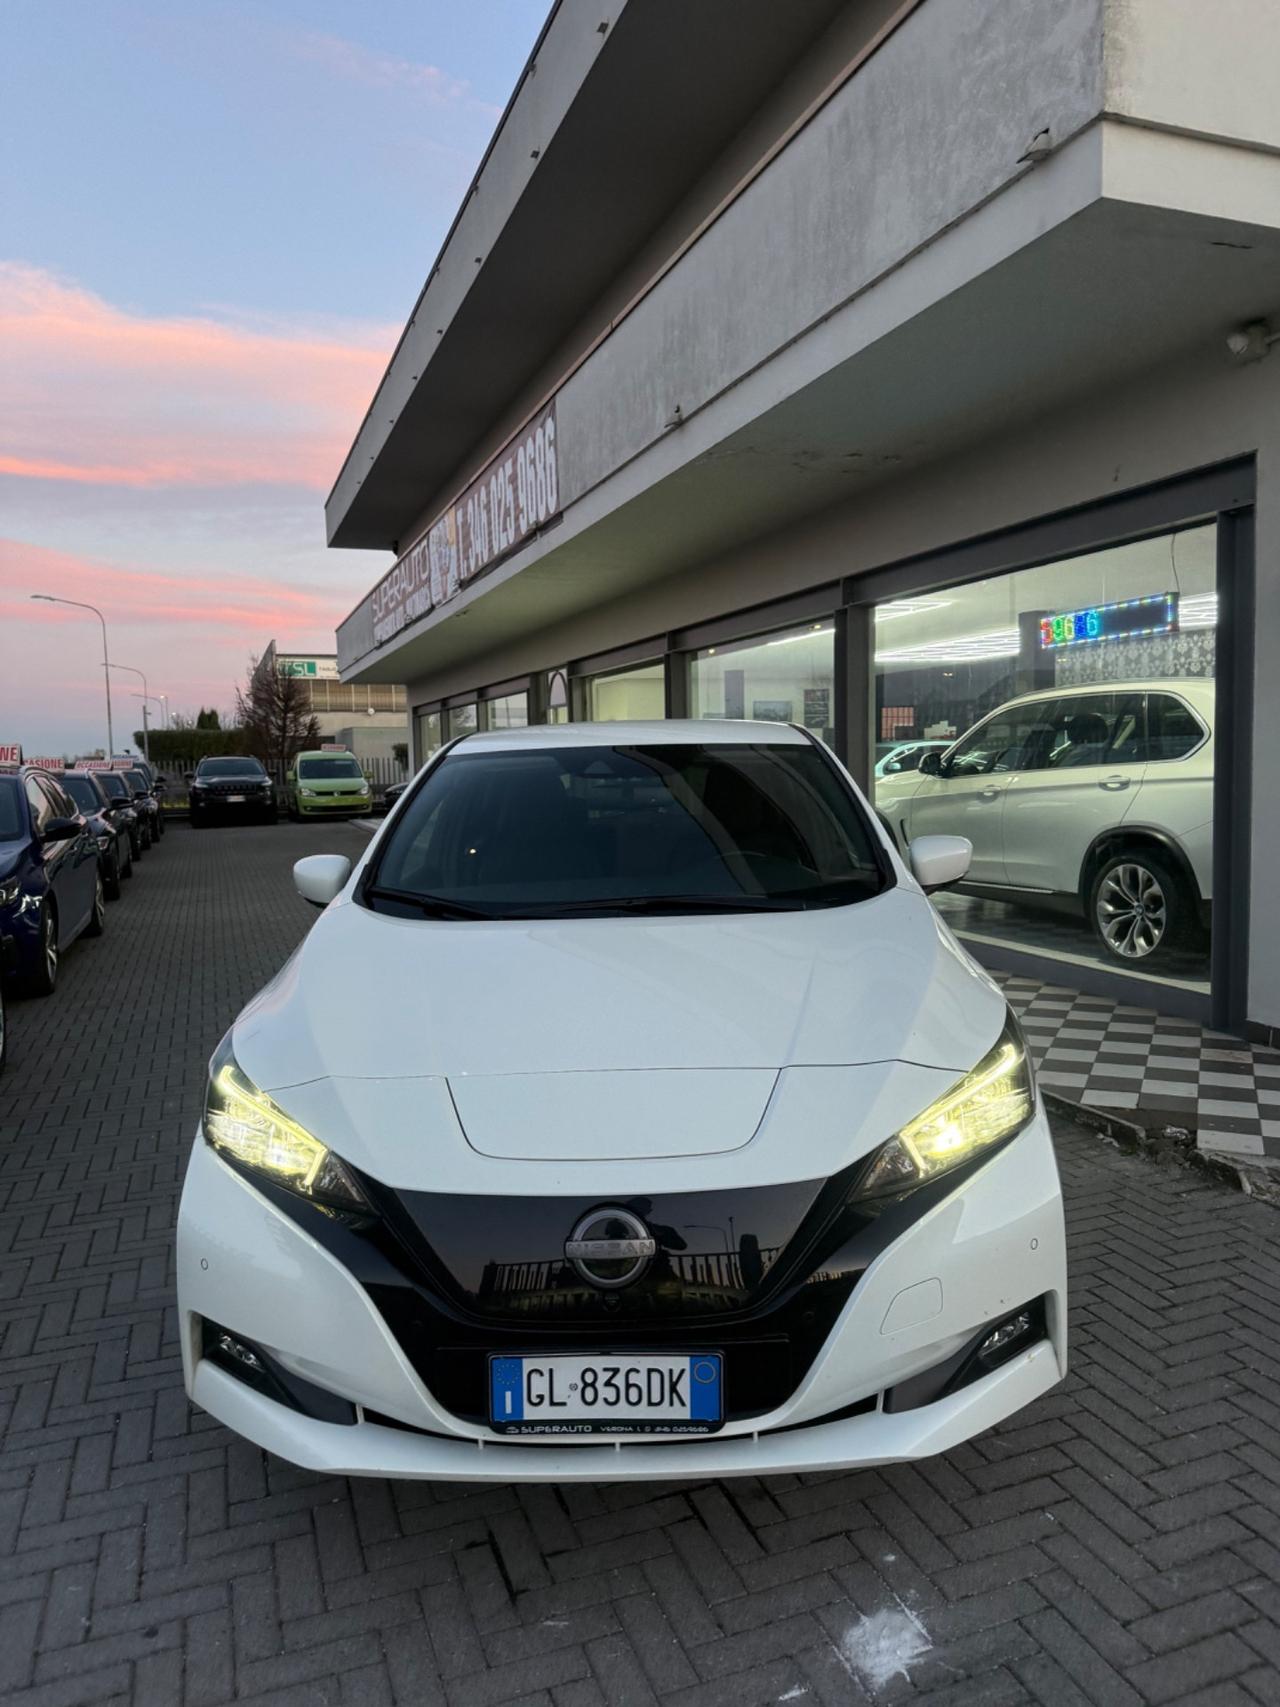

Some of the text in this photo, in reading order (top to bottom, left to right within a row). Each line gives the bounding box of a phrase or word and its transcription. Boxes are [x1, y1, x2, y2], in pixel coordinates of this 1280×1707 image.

[490, 458, 515, 553] 025
[517, 416, 558, 532] 9686
[372, 543, 430, 621] SUPERAUTO
[567, 1240, 654, 1257] NISSAN
[580, 1367, 687, 1407] 836DK
[521, 1425, 593, 1434] SUPERAUTO
